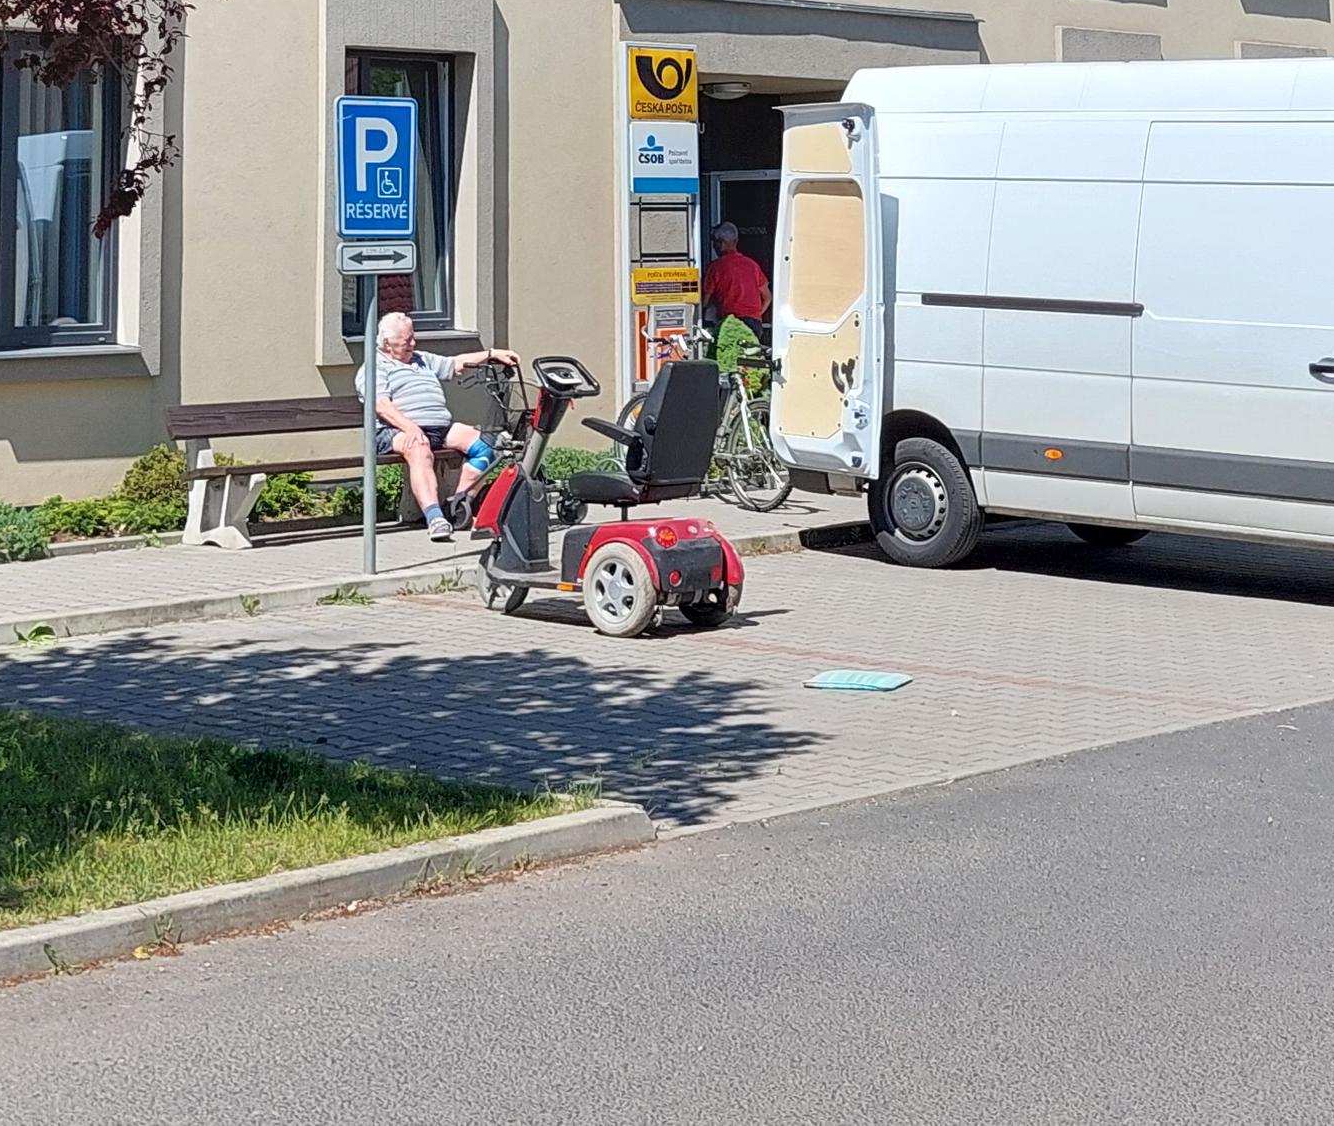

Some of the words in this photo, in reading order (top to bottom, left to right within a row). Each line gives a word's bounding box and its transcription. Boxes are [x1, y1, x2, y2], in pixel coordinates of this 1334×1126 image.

[635, 100, 664, 114] ČESKÁ
[666, 102, 693, 115] POŠTA
[355, 117, 398, 192] P
[638, 153, 664, 164] ČSOB
[346, 200, 408, 219] RÉSERVÉ
